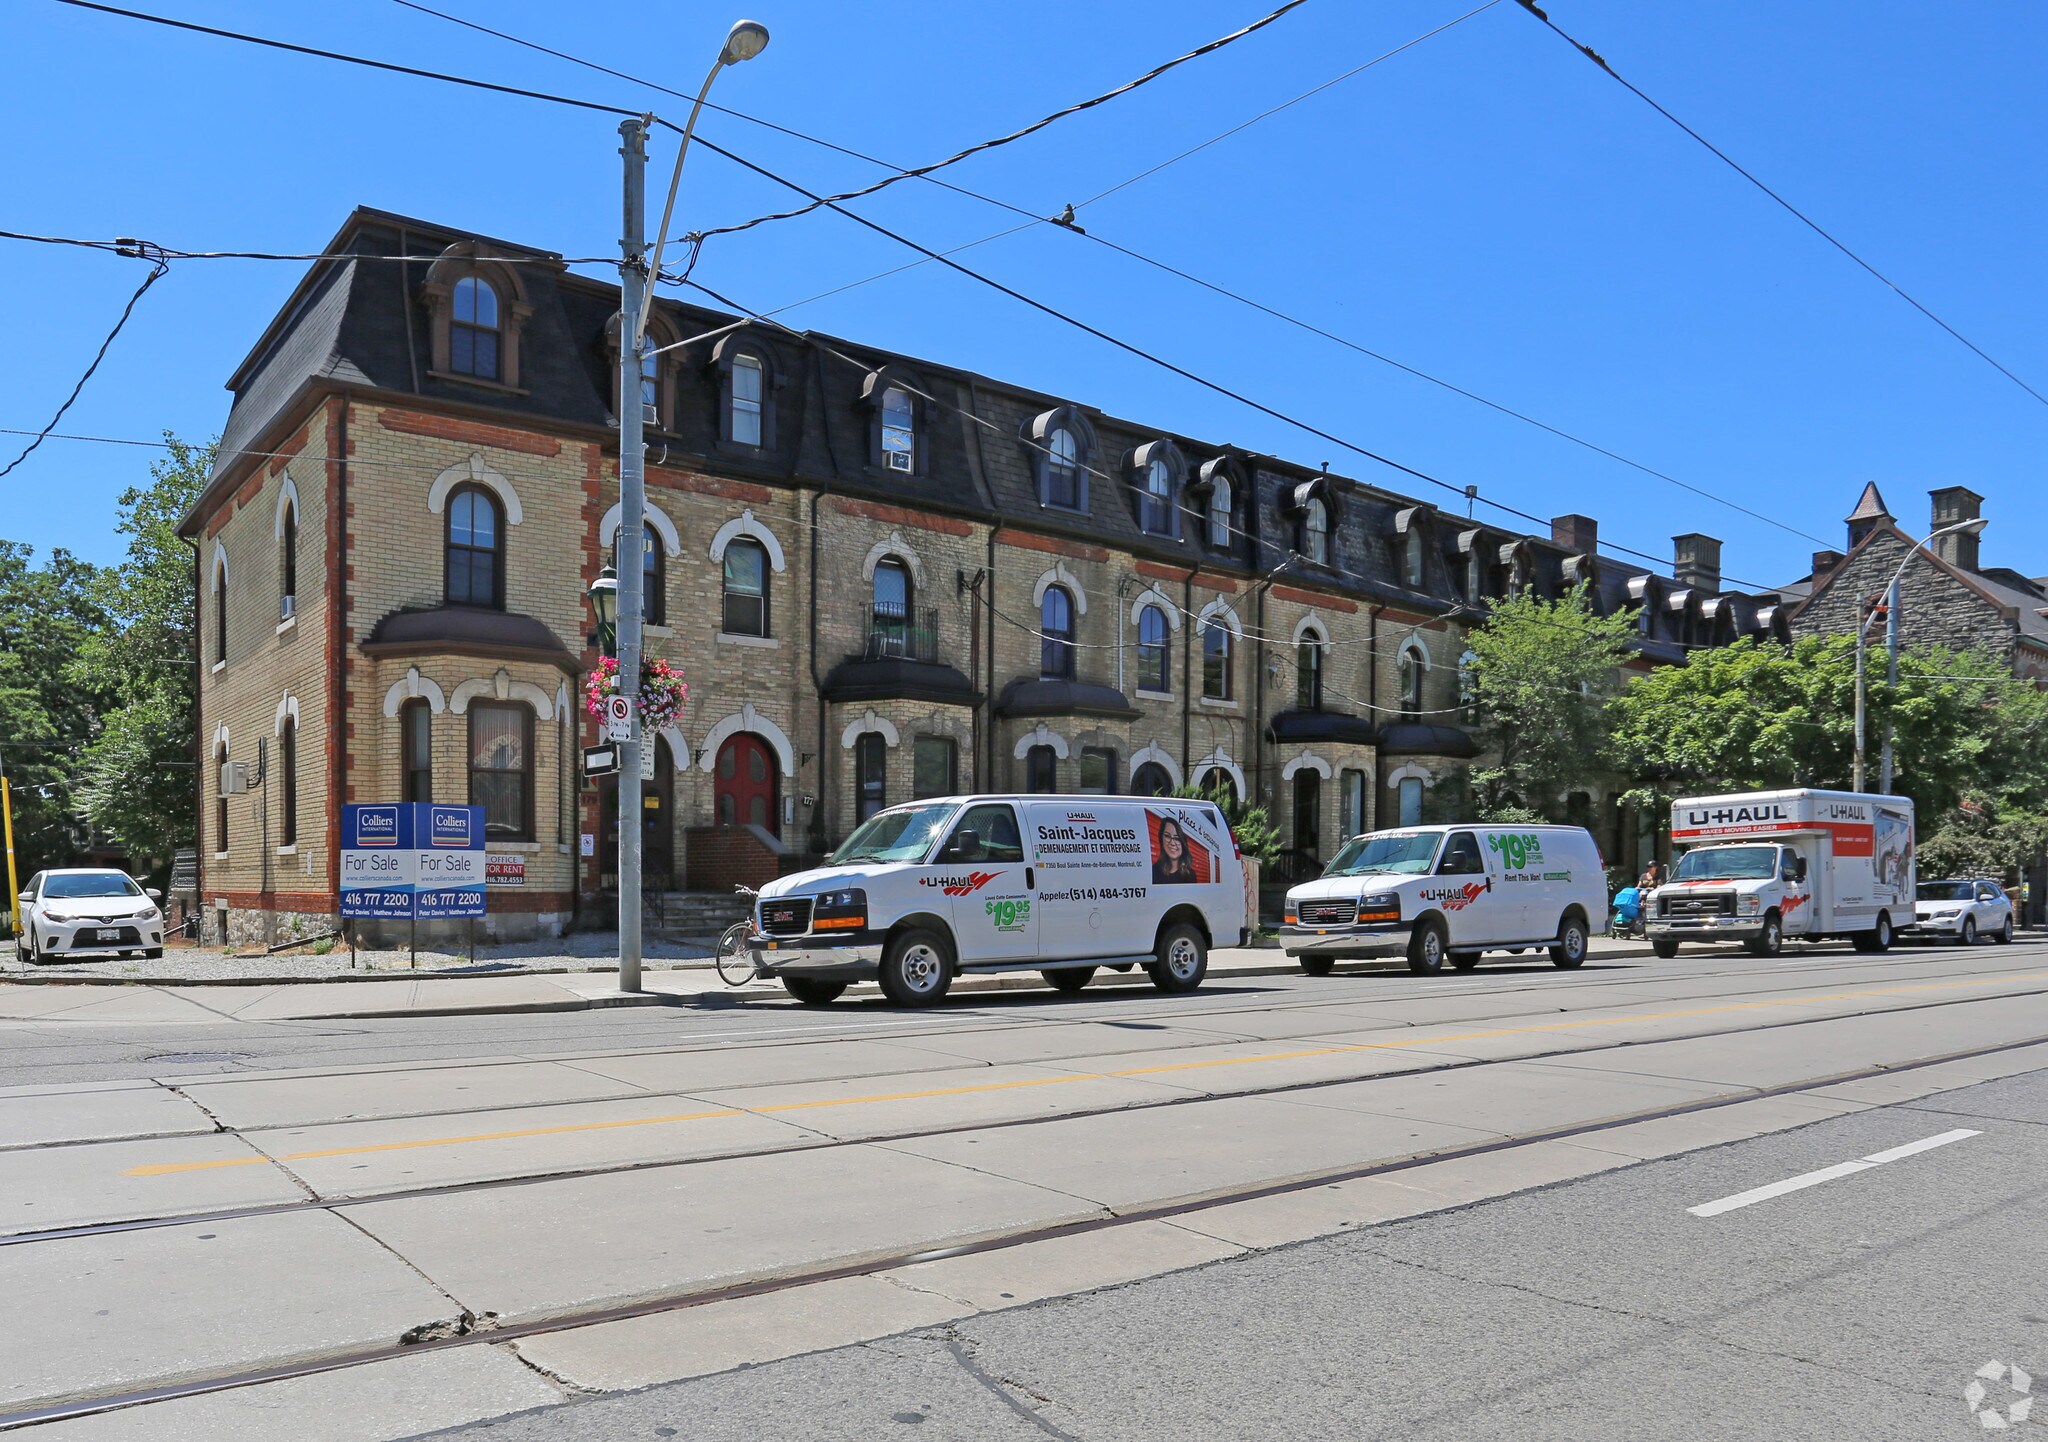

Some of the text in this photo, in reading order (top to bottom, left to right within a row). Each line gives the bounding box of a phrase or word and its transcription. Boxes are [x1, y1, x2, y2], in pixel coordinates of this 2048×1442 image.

[804, 797, 814, 806] 177
[1689, 805, 1787, 825] U-HAUL
[1830, 804, 1866, 820] U-HAUL
[362, 815, 393, 826] Colliers
[436, 814, 466, 827] Colliers
[1038, 826, 1135, 842] Saint-Jacques
[1039, 844, 1141, 853] DEMENAGEMENT ET ENTREPOSAGE
[346, 854, 398, 870] For Sale
[421, 854, 471, 871] For Sale
[486, 865, 523, 874] FOR RENT
[927, 877, 974, 887] U-HAUL
[345, 893, 408, 906] 416 777 2200
[421, 893, 480, 905] 416 777 2200
[1040, 888, 1146, 902] Appelez (514) 484-3767
[1426, 889, 1468, 900] U-HAUL
